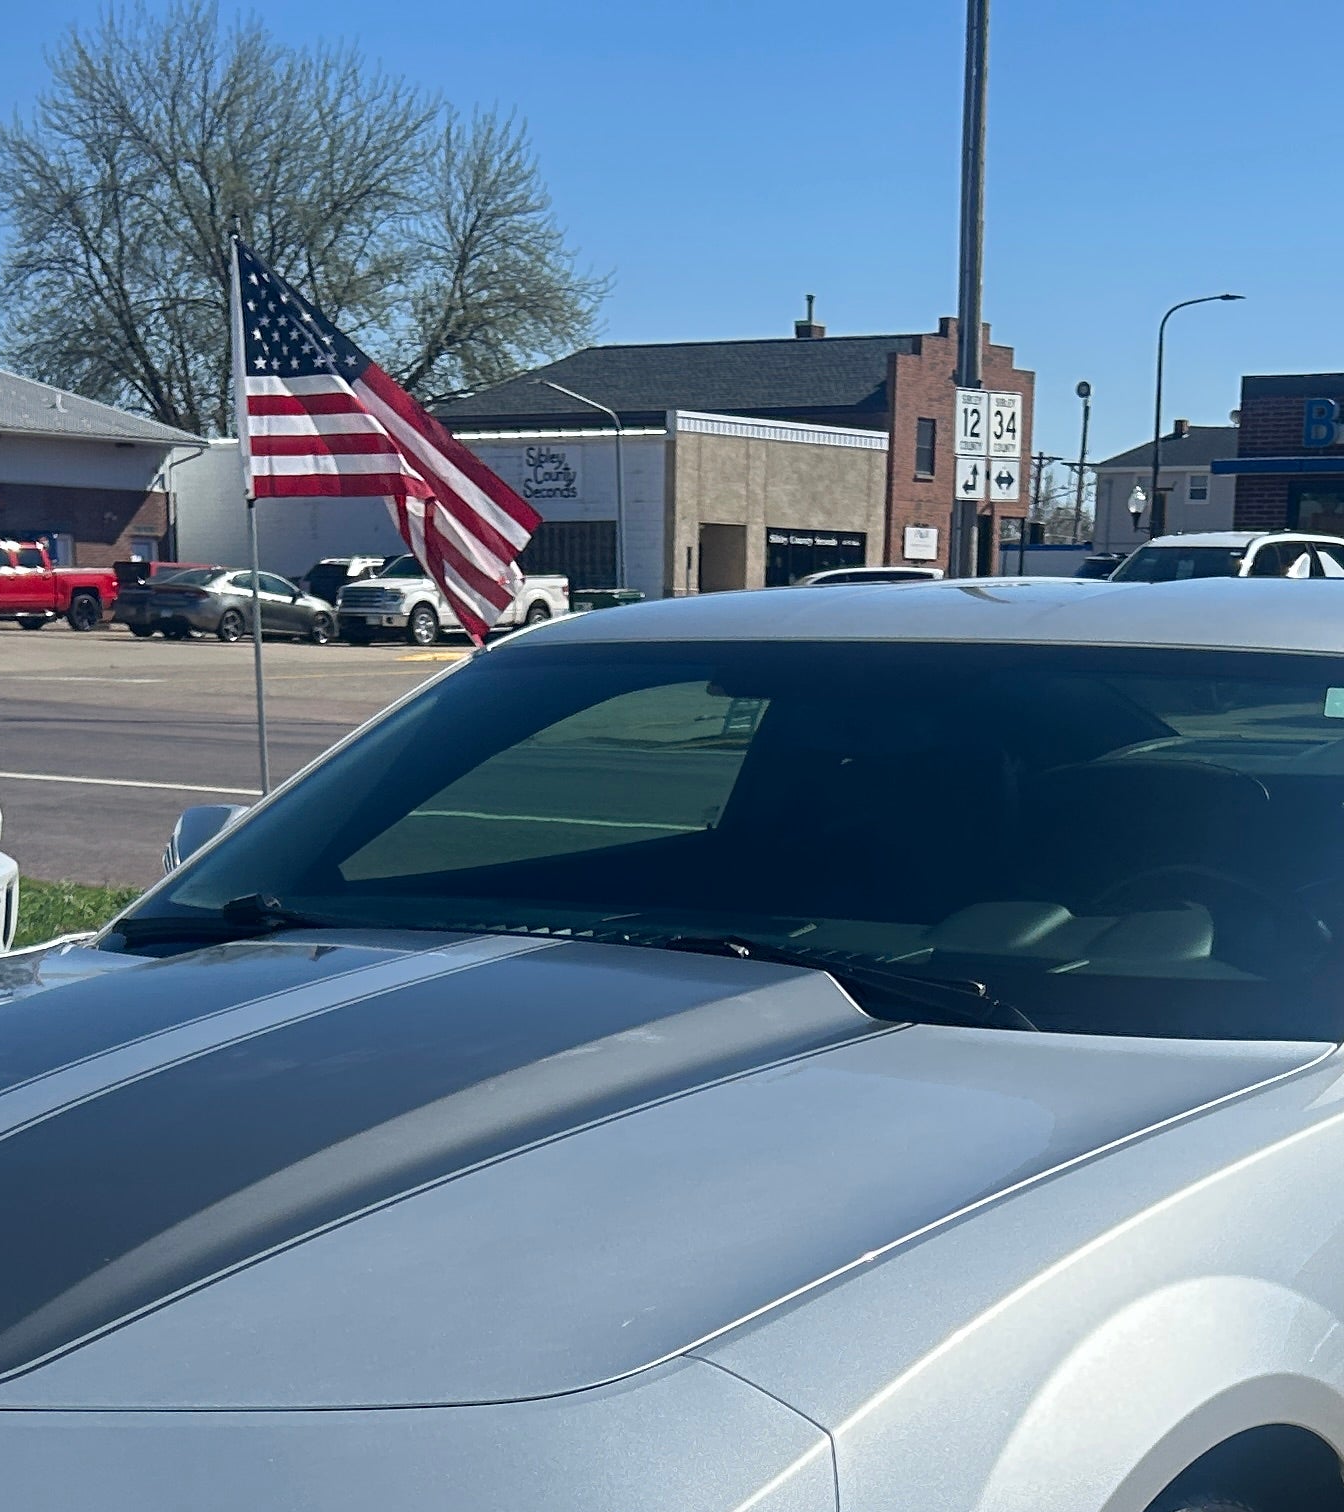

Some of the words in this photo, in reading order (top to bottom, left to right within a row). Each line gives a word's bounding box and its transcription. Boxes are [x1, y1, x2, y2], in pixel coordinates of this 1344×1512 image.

[963, 407, 981, 438] 12
[993, 410, 1016, 440] 34
[959, 440, 983, 450] COUNTY
[993, 443, 1016, 452] COUNTY
[525, 446, 566, 470] Sibley
[522, 478, 577, 498] Seconds
[533, 464, 577, 488] County
